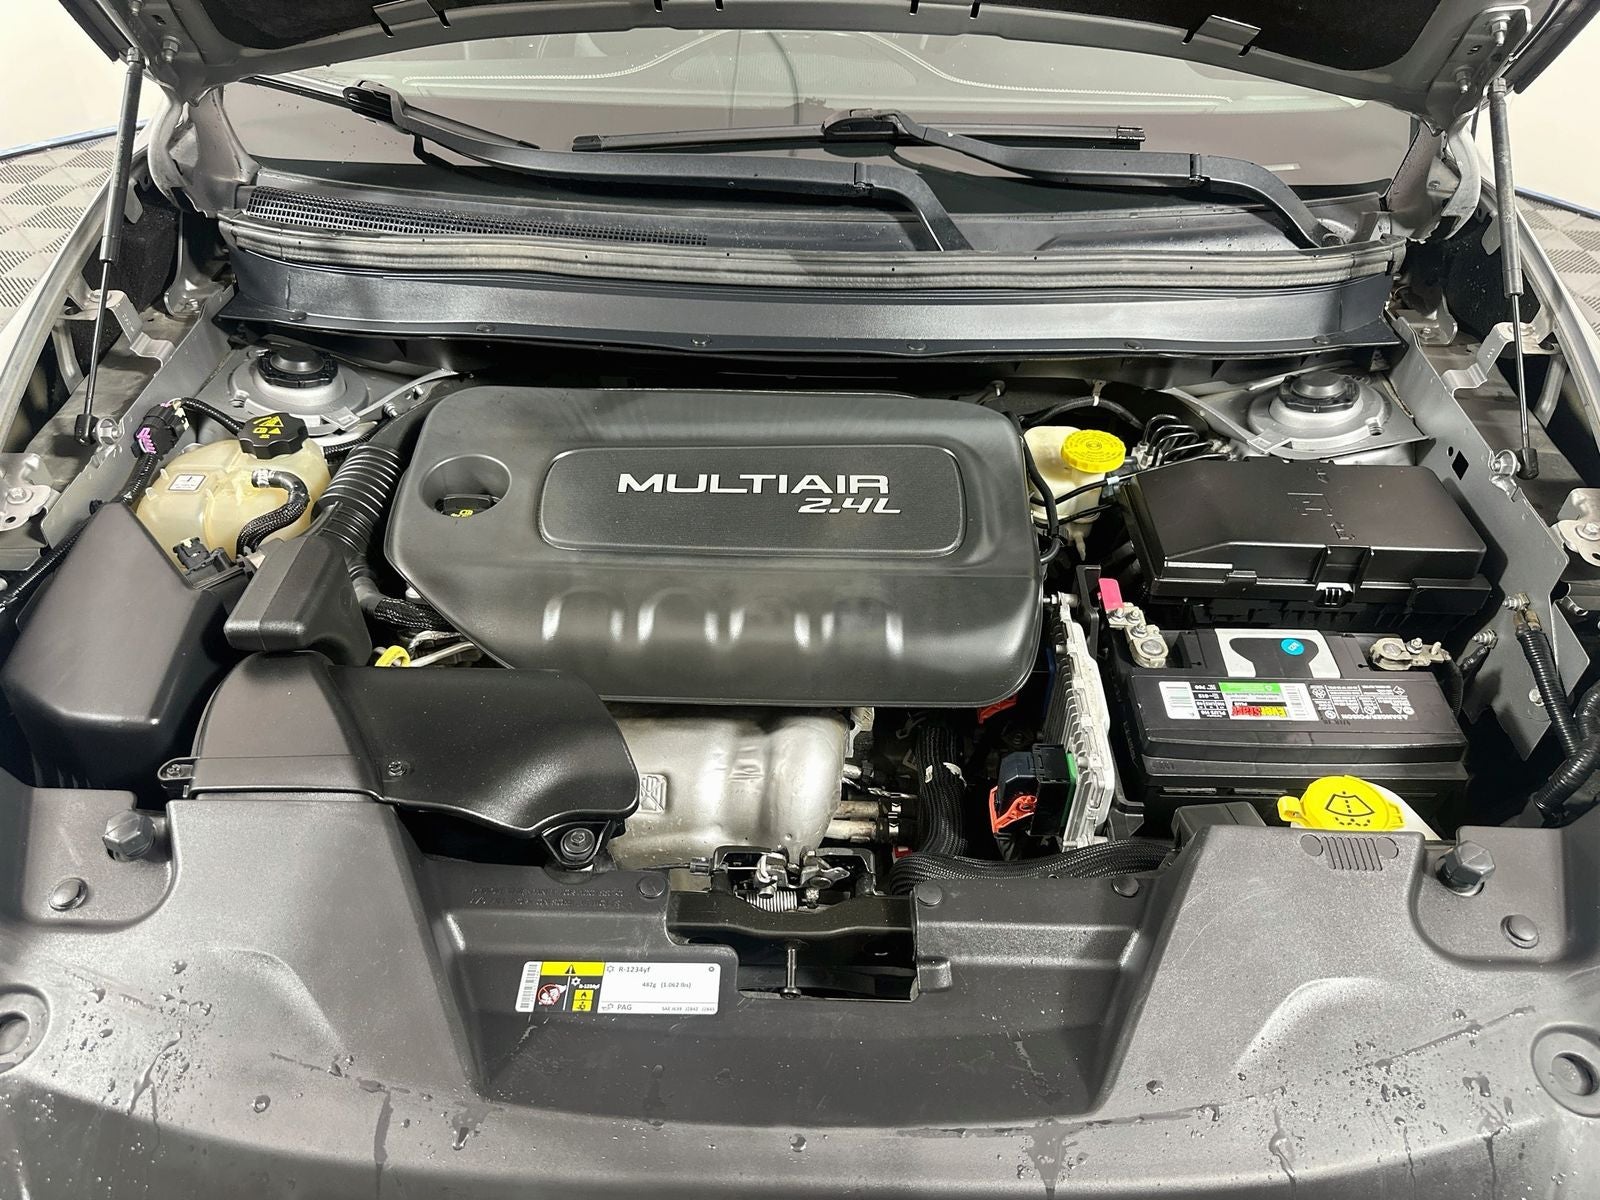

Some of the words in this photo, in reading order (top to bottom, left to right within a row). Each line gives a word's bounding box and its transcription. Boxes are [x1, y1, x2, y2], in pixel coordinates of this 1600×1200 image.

[617, 473, 889, 494] MULTIAIR
[798, 497, 901, 513] 2.4L
[1231, 705, 1288, 717] EverStart
[618, 966, 651, 974] R-1234yf
[617, 1003, 632, 1011] PAG
